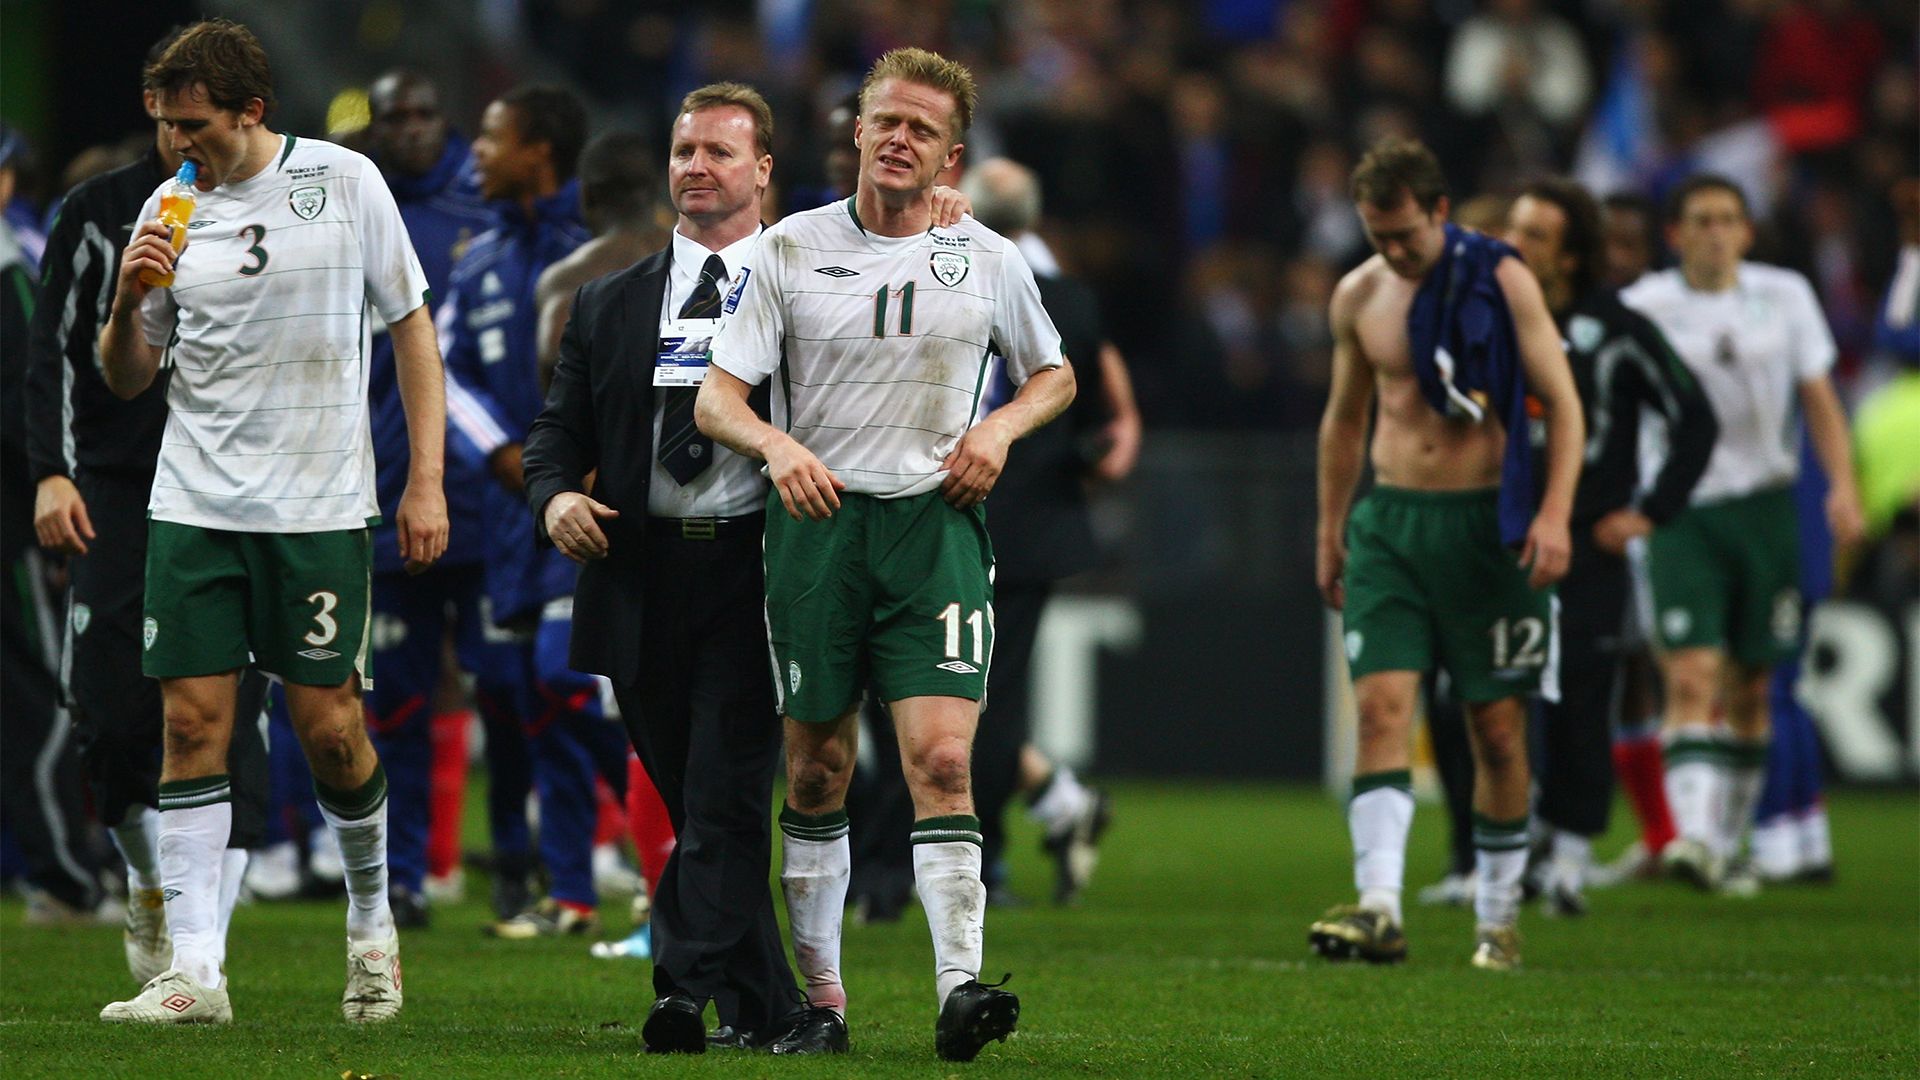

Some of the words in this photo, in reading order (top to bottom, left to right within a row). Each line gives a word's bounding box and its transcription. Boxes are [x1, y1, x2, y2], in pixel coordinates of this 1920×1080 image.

[237, 223, 269, 276] 3
[872, 280, 917, 339] 11
[303, 590, 338, 647] 3
[935, 602, 983, 665] 11
[1489, 615, 1546, 668] 12
